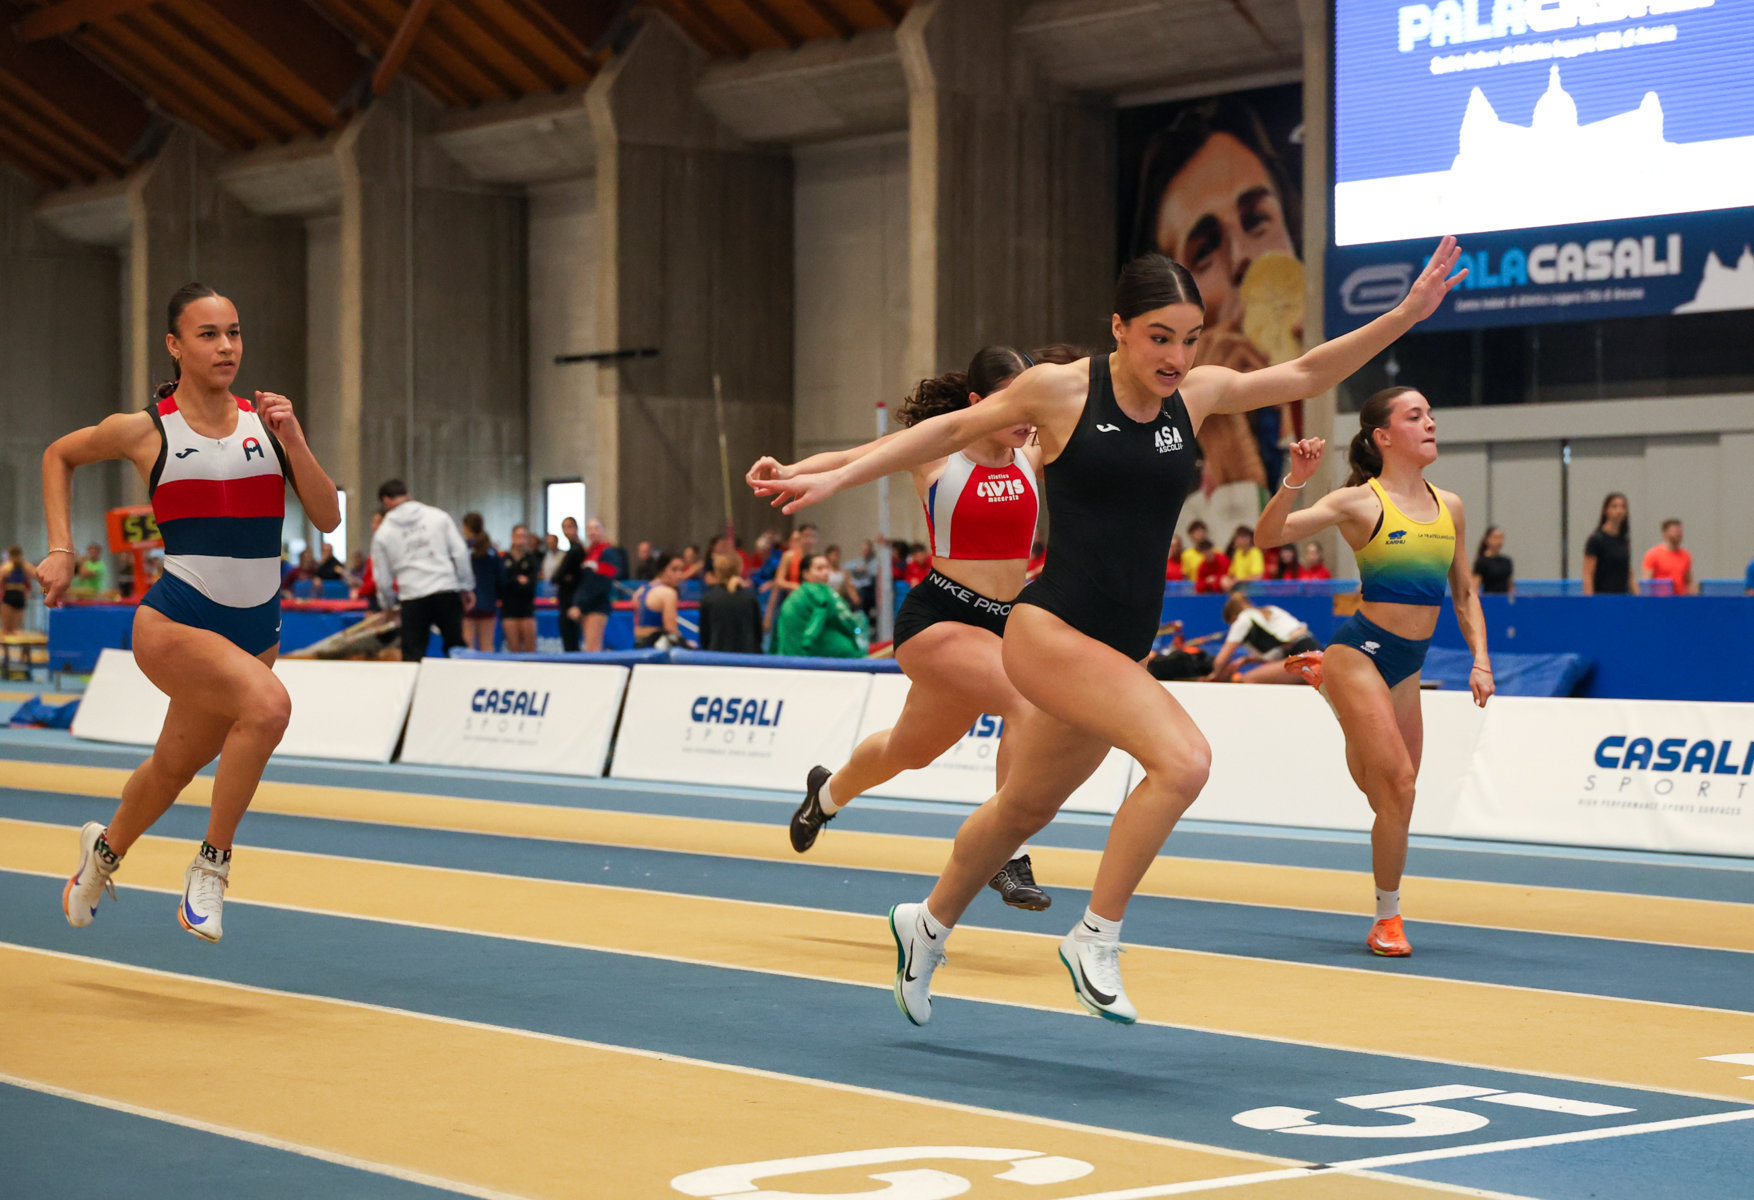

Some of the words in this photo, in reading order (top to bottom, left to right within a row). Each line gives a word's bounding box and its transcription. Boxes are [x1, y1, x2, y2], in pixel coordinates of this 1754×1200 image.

[1154, 425, 1183, 448] ASA
[929, 572, 975, 604] NIKE
[973, 597, 1012, 616] PRO
[471, 688, 550, 717] CASALI
[690, 695, 785, 727] CASALI
[1583, 774, 1749, 800] SPORT
